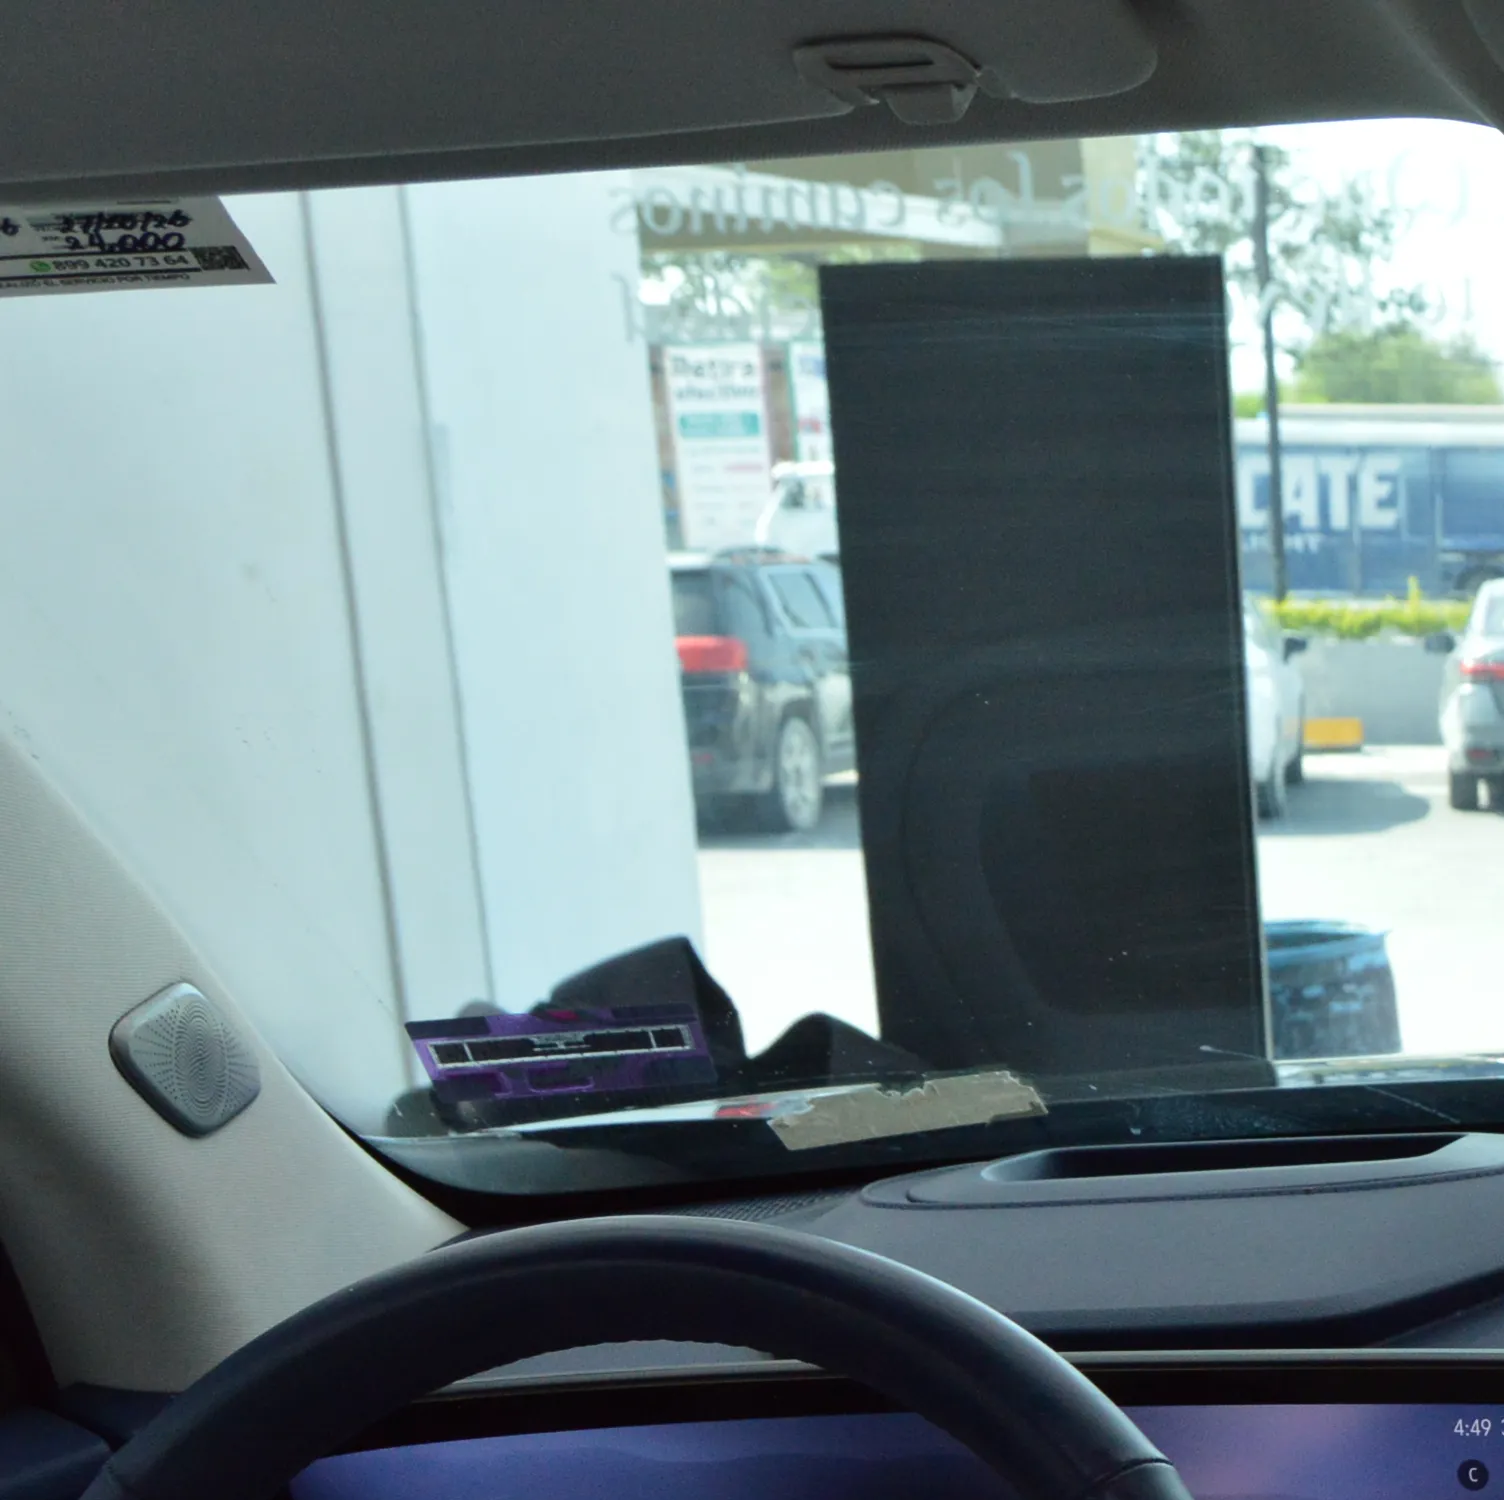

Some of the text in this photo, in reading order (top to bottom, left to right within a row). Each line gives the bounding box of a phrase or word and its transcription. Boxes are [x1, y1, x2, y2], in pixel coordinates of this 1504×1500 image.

[53, 254, 189, 271] 899 420 73 64
[1453, 1417, 1492, 1437] 4:49
[1468, 1467, 1479, 1483] C
